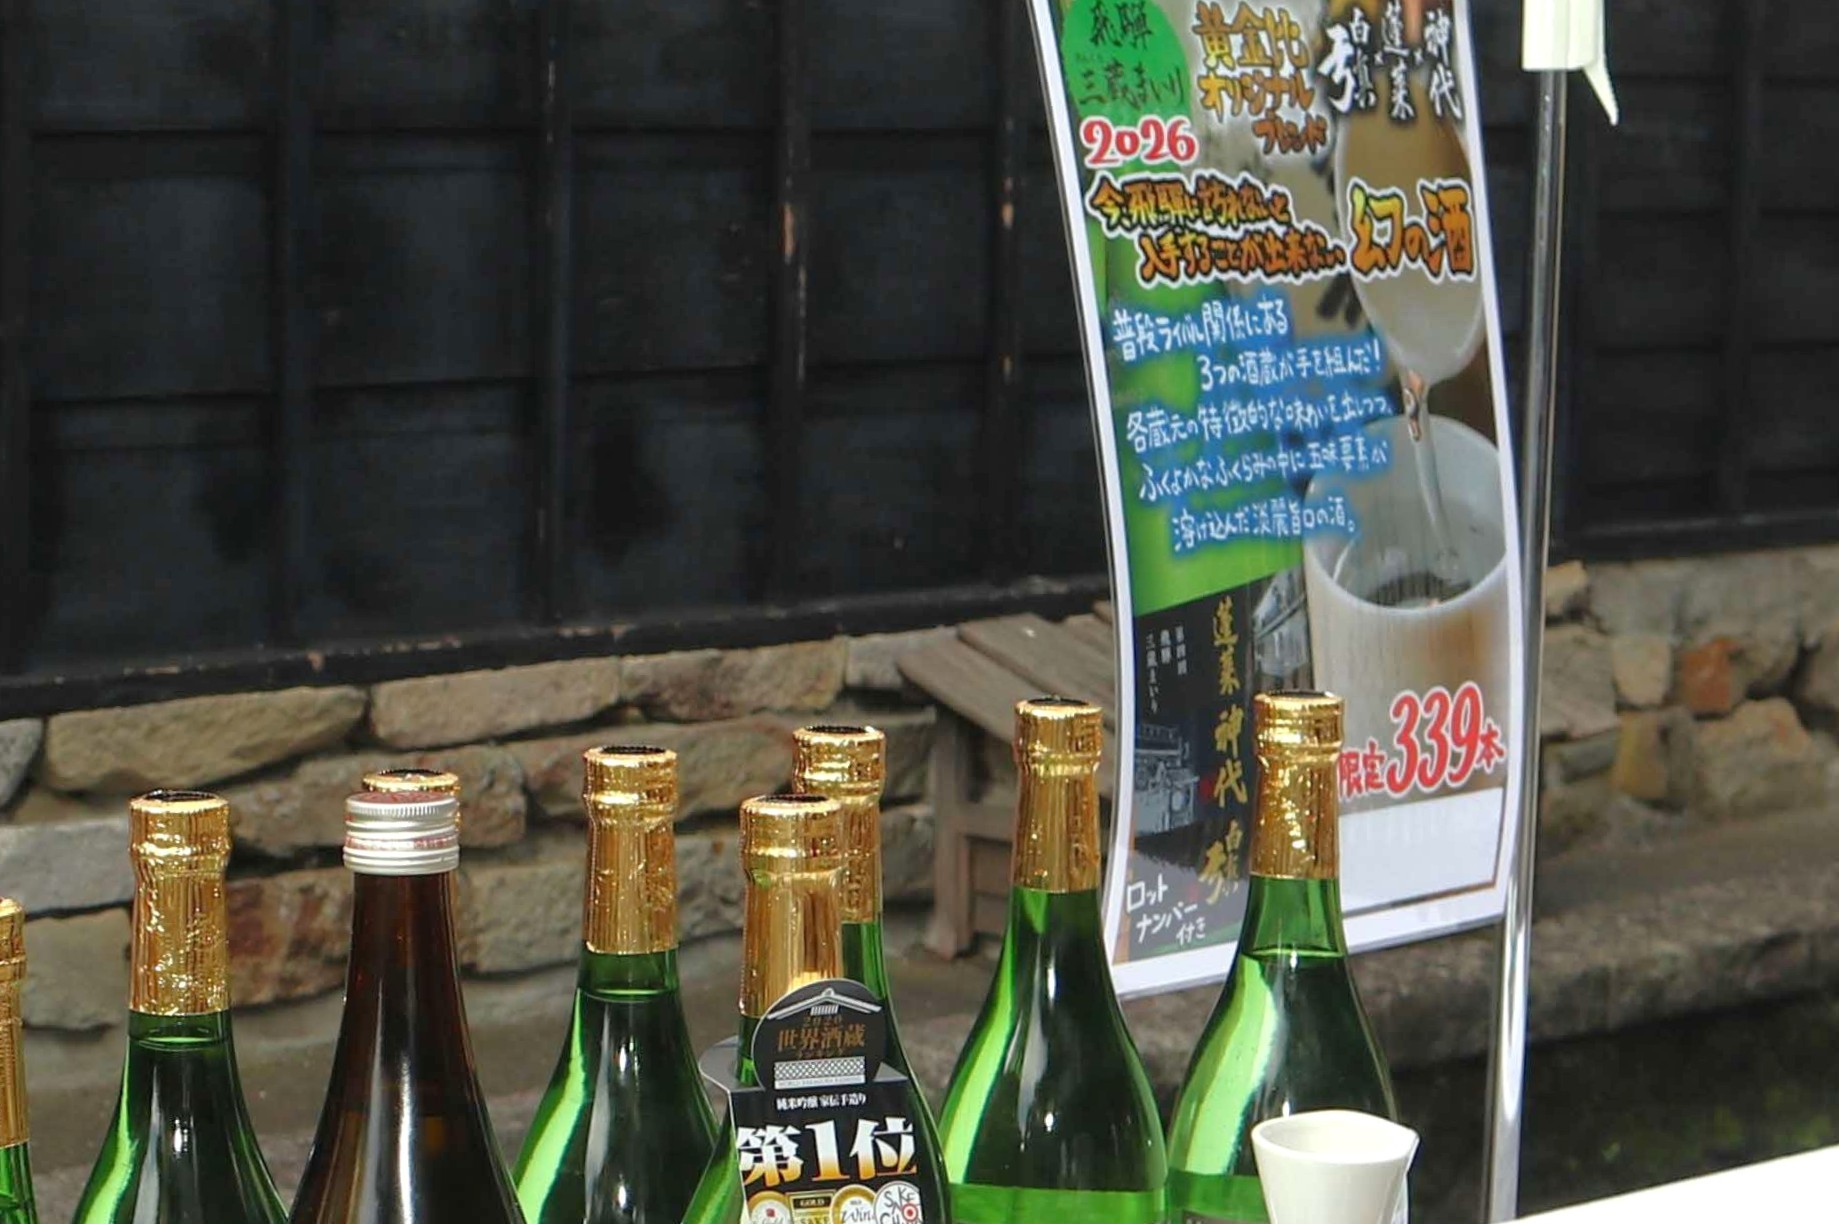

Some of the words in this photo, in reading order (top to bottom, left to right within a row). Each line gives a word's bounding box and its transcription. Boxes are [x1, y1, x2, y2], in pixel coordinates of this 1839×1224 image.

[1192, 1, 1310, 70] 黄金比
[1197, 68, 1314, 120] オリジナル
[1082, 117, 1196, 163] 2026
[1252, 110, 1329, 153] ブレンド
[1139, 227, 1346, 281] 入手することが出来ない
[1351, 181, 1474, 277] 幻の酒
[1113, 299, 1288, 361] 普段ライバル関係にある
[1214, 704, 1248, 808] 神代
[1127, 873, 1169, 913] ロット
[1136, 901, 1198, 944] ナンバー
[1176, 917, 1206, 945] 付き
[736, 1117, 917, 1187] 第1位
